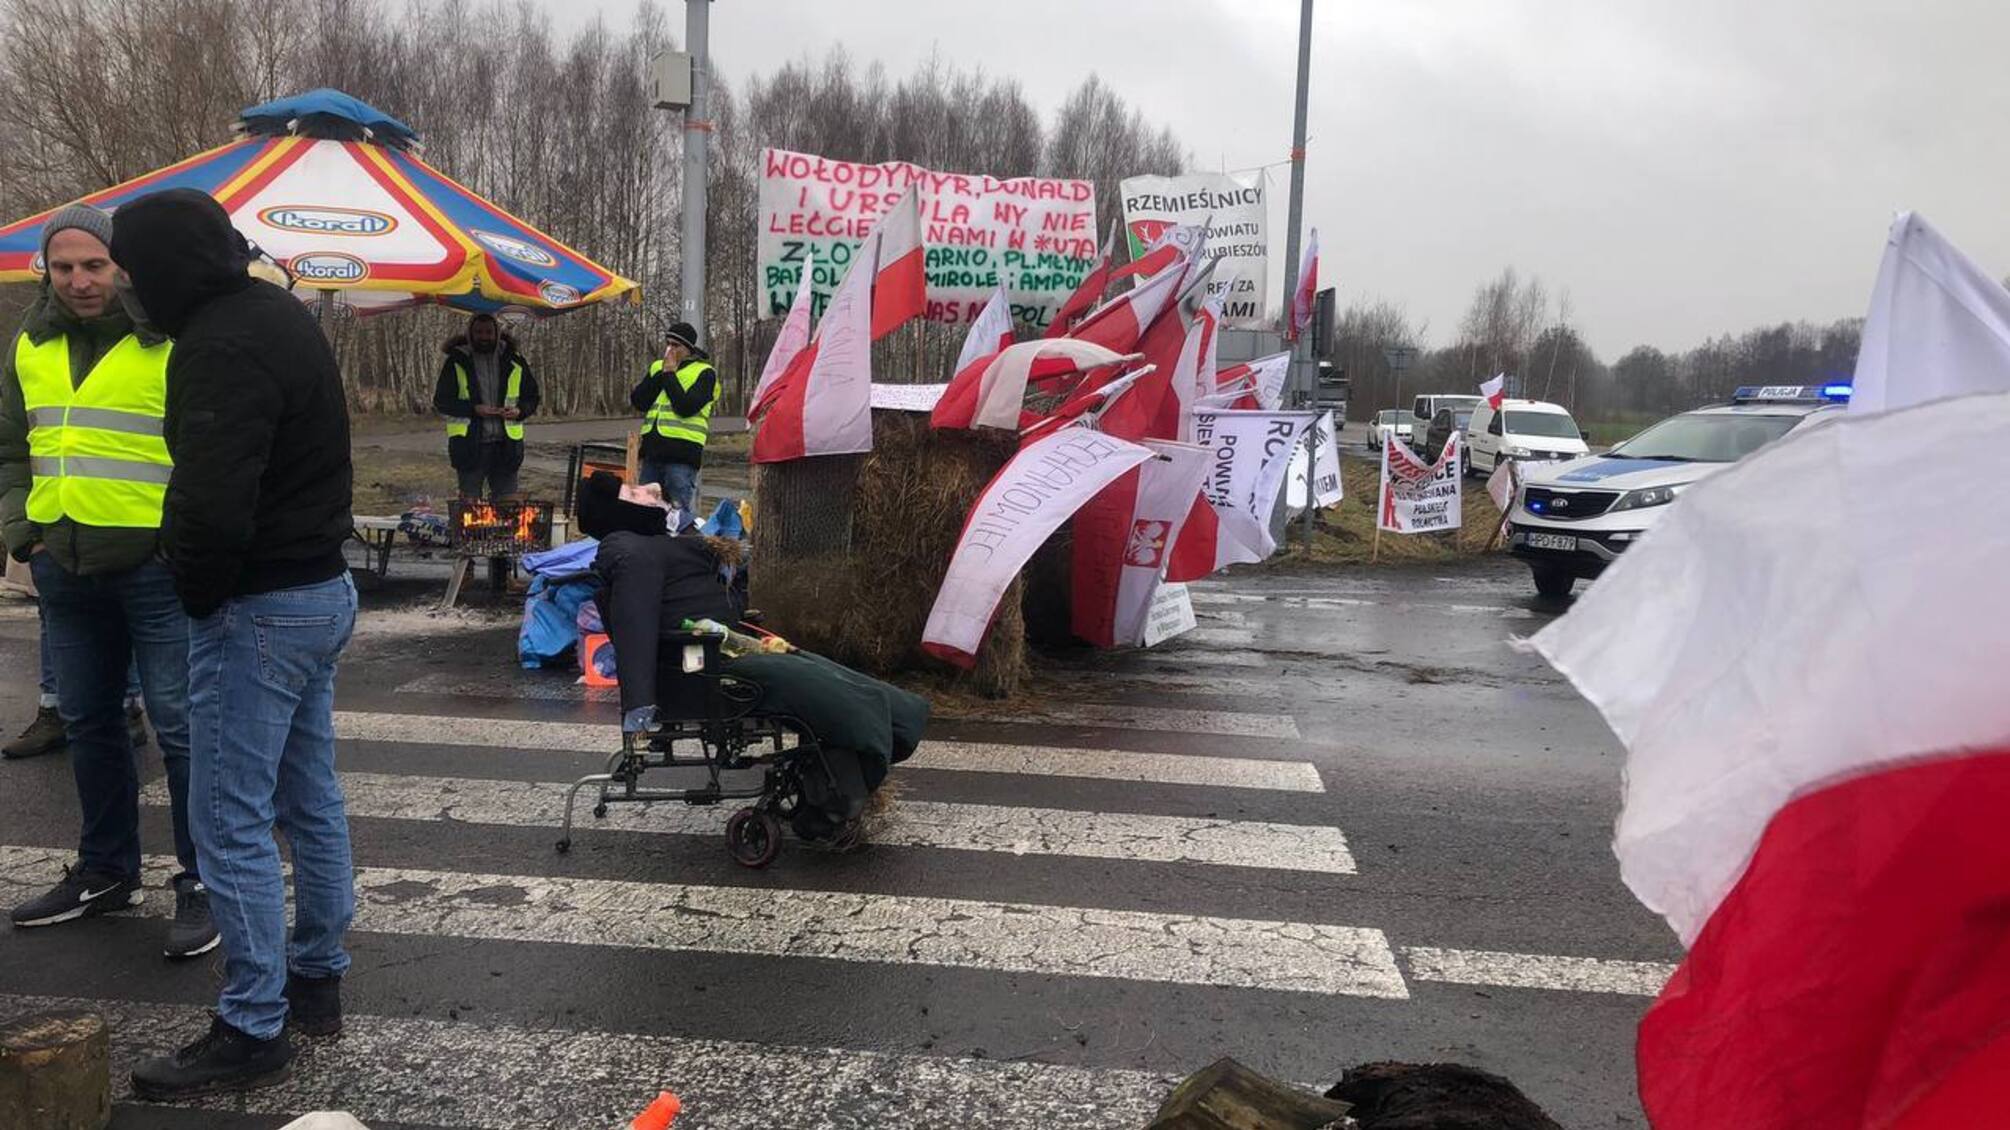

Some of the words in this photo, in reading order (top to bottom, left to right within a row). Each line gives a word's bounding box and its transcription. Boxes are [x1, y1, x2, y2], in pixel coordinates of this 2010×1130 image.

[800, 187, 807, 208] I
[994, 202, 1028, 226] WY
[1043, 212, 1092, 231] NIE
[1127, 188, 1262, 213] RZEMIEŚLNICY
[927, 225, 996, 248] NAMI
[1008, 230, 1025, 249] W
[1206, 223, 1259, 240] OWIATU
[1238, 280, 1255, 293] ZA
[1221, 302, 1256, 317] AMI
[963, 437, 1119, 564] IECHANOWIEC
